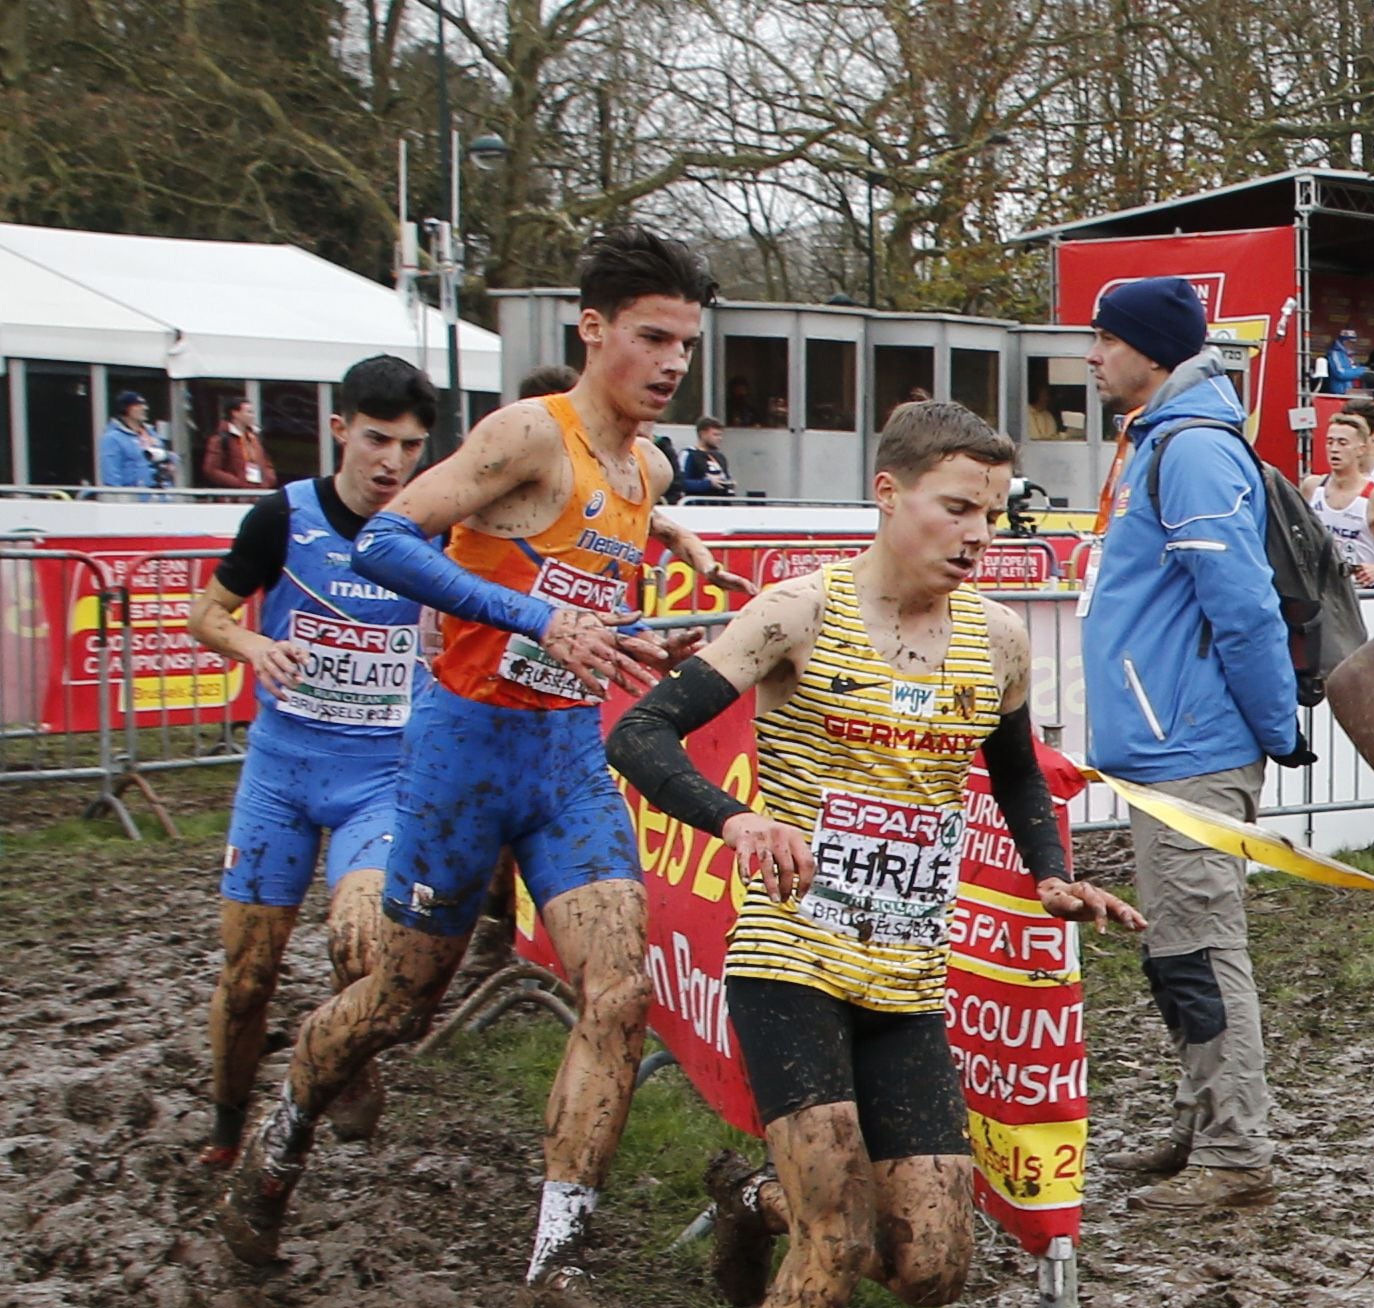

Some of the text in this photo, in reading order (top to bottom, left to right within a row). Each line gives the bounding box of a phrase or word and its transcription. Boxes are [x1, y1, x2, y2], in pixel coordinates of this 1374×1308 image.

[330, 580, 398, 600] ITALIA
[543, 568, 615, 609] SPAR
[296, 618, 386, 650] SPAR
[289, 695, 363, 721] BRUSSELS
[823, 713, 979, 755] GERMANY
[826, 798, 939, 842] SPAR
[817, 842, 952, 899] EHRLE
[949, 907, 1064, 961] SPAR
